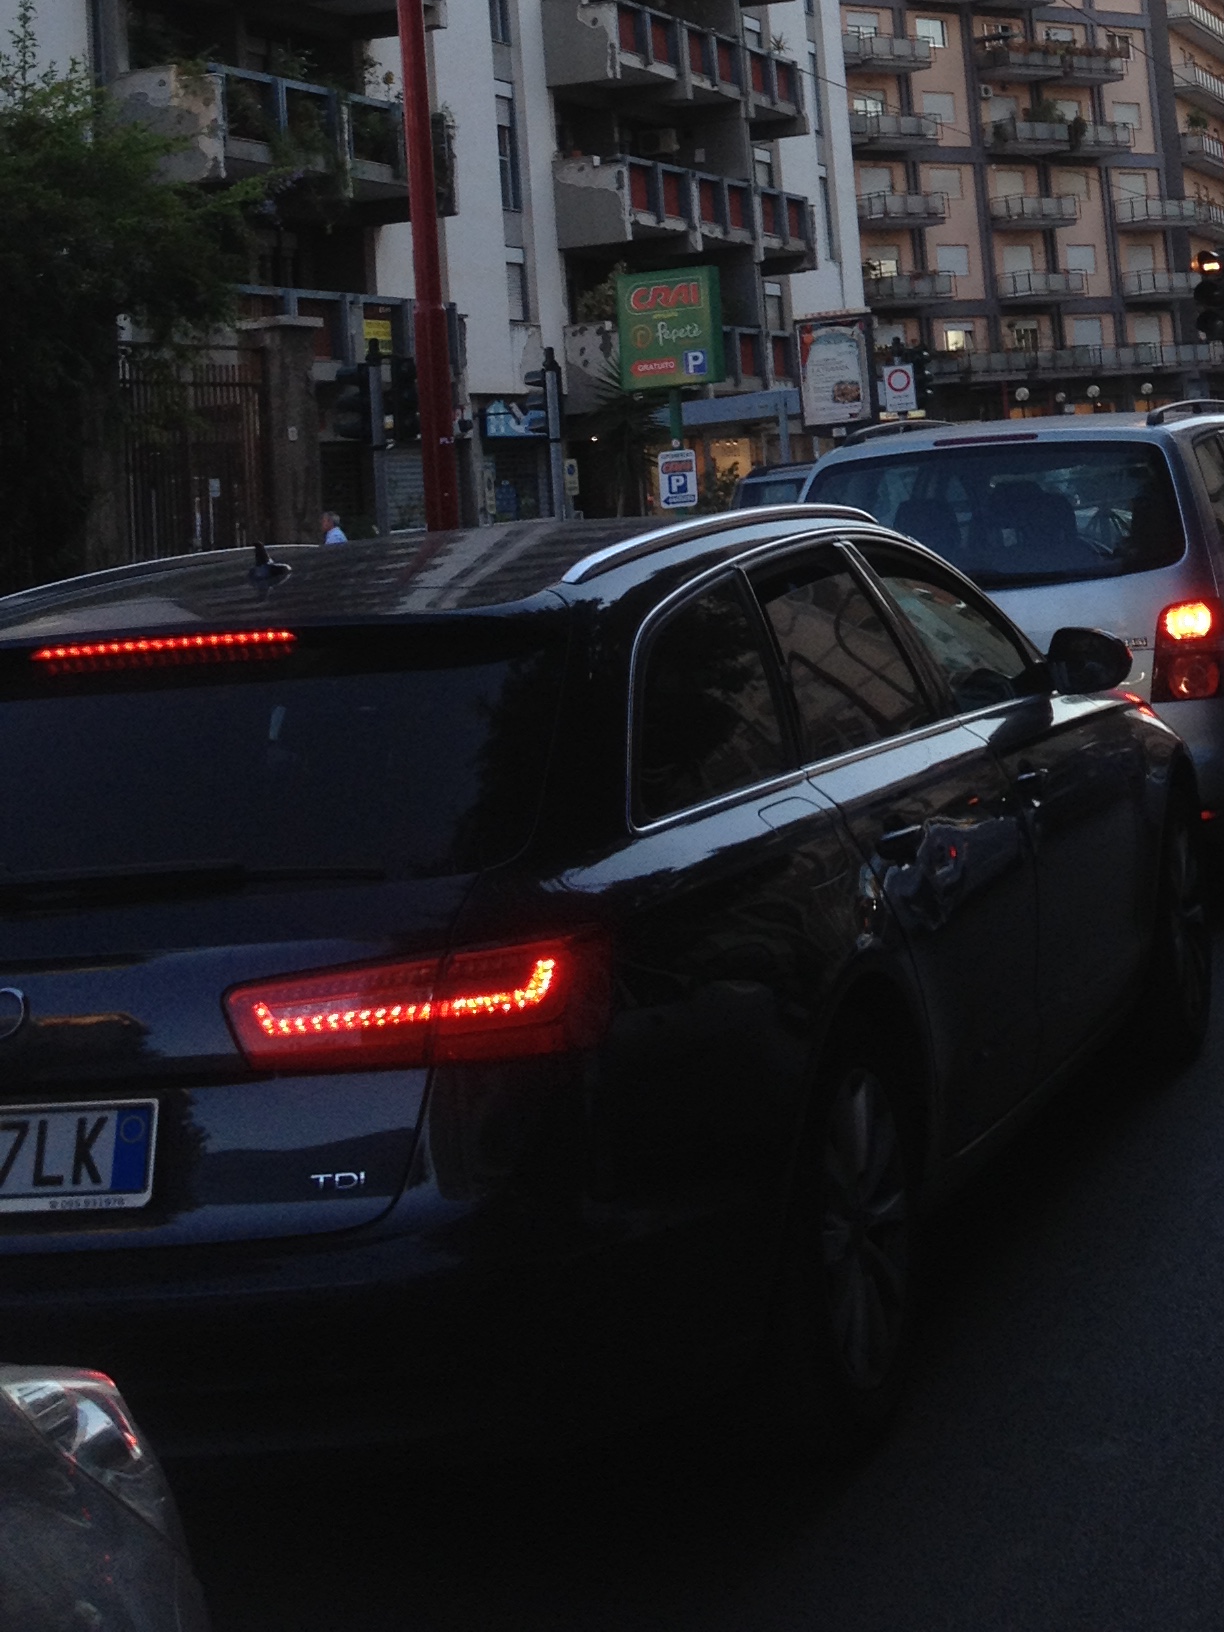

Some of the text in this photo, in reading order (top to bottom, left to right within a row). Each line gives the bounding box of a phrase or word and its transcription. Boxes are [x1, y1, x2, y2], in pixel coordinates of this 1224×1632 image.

[631, 282, 699, 311] CRAI
[687, 351, 704, 374] P
[671, 475, 685, 493] P
[0, 1117, 108, 1187] 7LK
[310, 1171, 365, 1189] TDI
